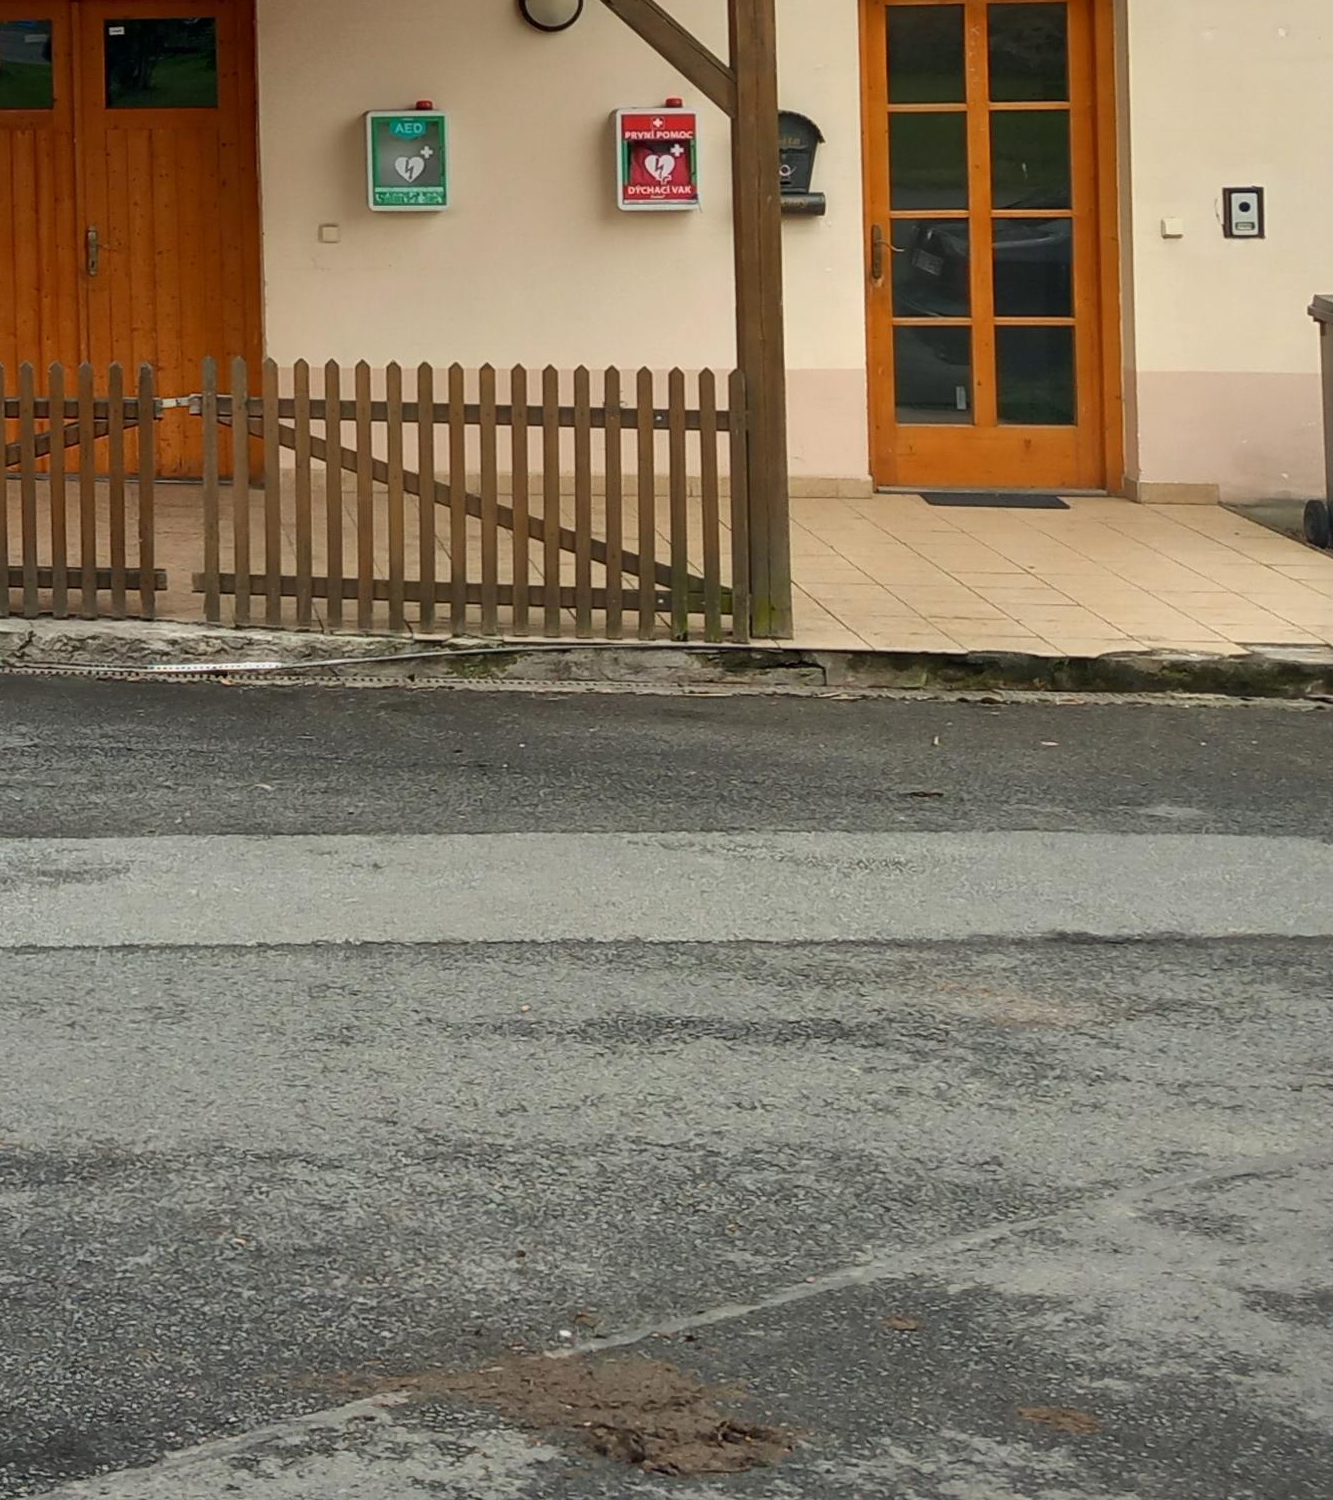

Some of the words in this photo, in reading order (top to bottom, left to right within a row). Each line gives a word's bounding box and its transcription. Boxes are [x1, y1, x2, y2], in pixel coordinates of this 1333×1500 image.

[395, 123, 423, 134] AED
[624, 130, 655, 139] PRVNÍ
[656, 130, 693, 140] POMOC
[628, 184, 671, 195] DÝCHACÍ
[672, 185, 692, 194] VAK
